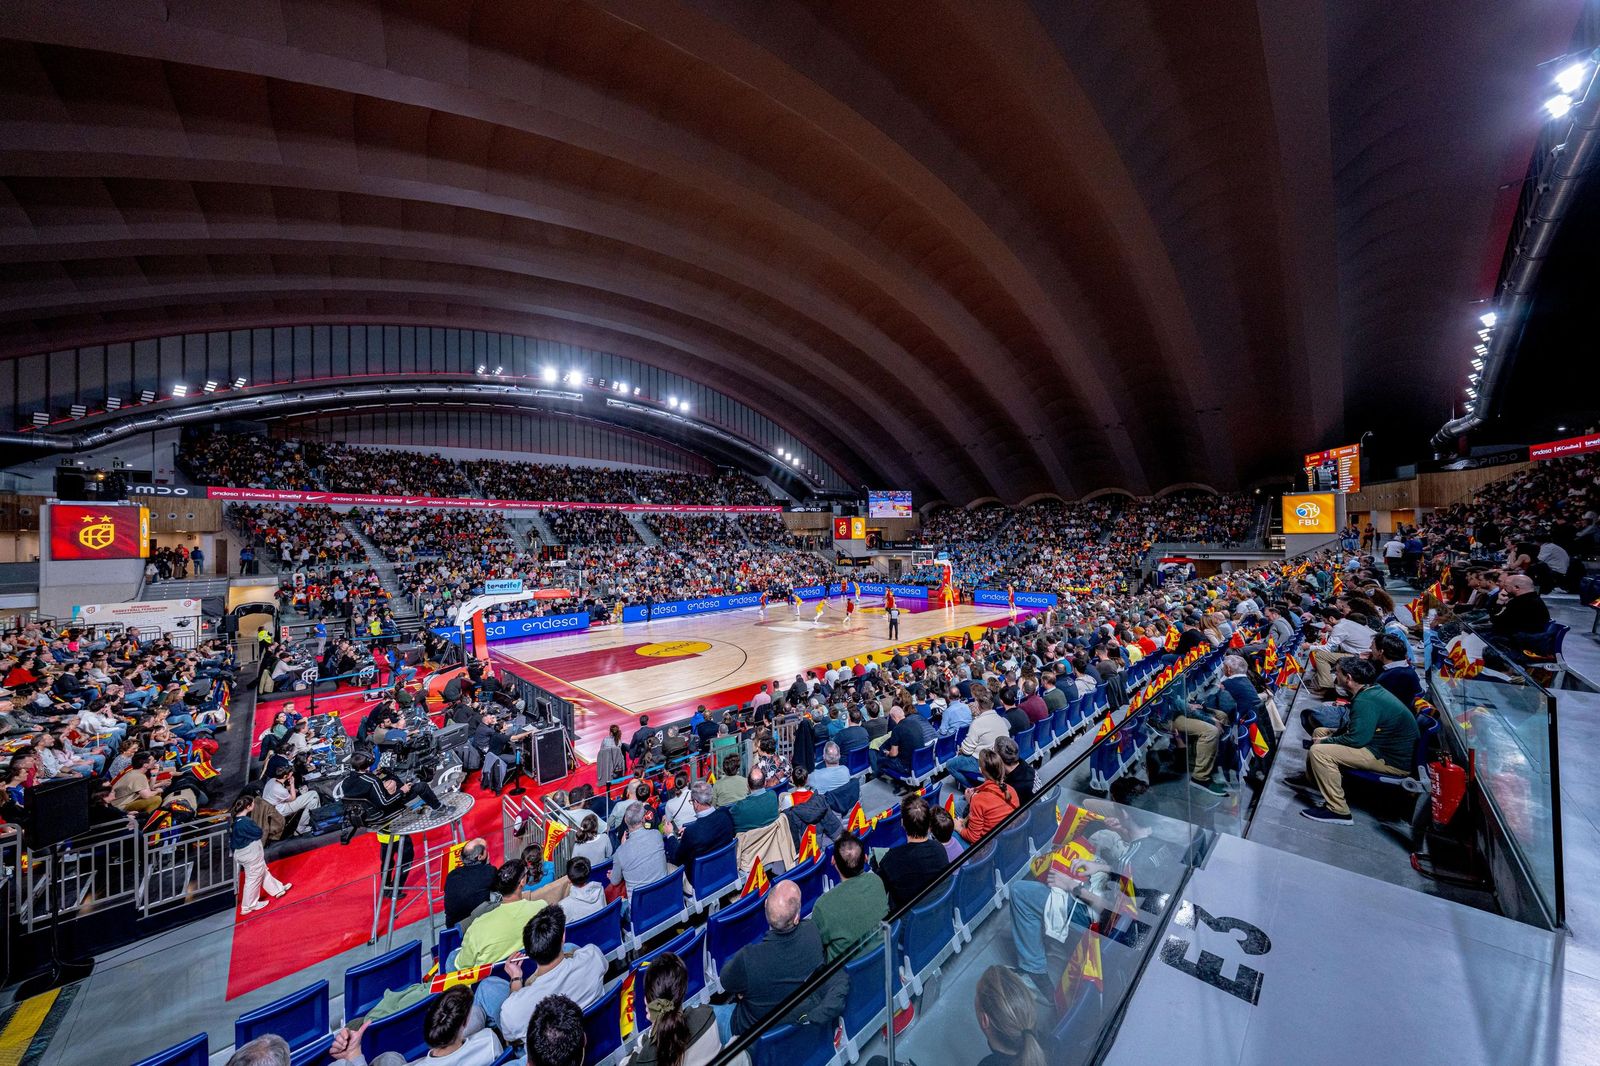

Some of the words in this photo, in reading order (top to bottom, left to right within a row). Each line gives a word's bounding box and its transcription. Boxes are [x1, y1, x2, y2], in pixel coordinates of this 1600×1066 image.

[1532, 448, 1552, 456] endesa
[687, 600, 720, 611] endesa
[728, 595, 758, 605] endesa
[1017, 596, 1048, 604] endesa
[522, 617, 578, 632] endesa
[1158, 898, 1272, 1007] E3
